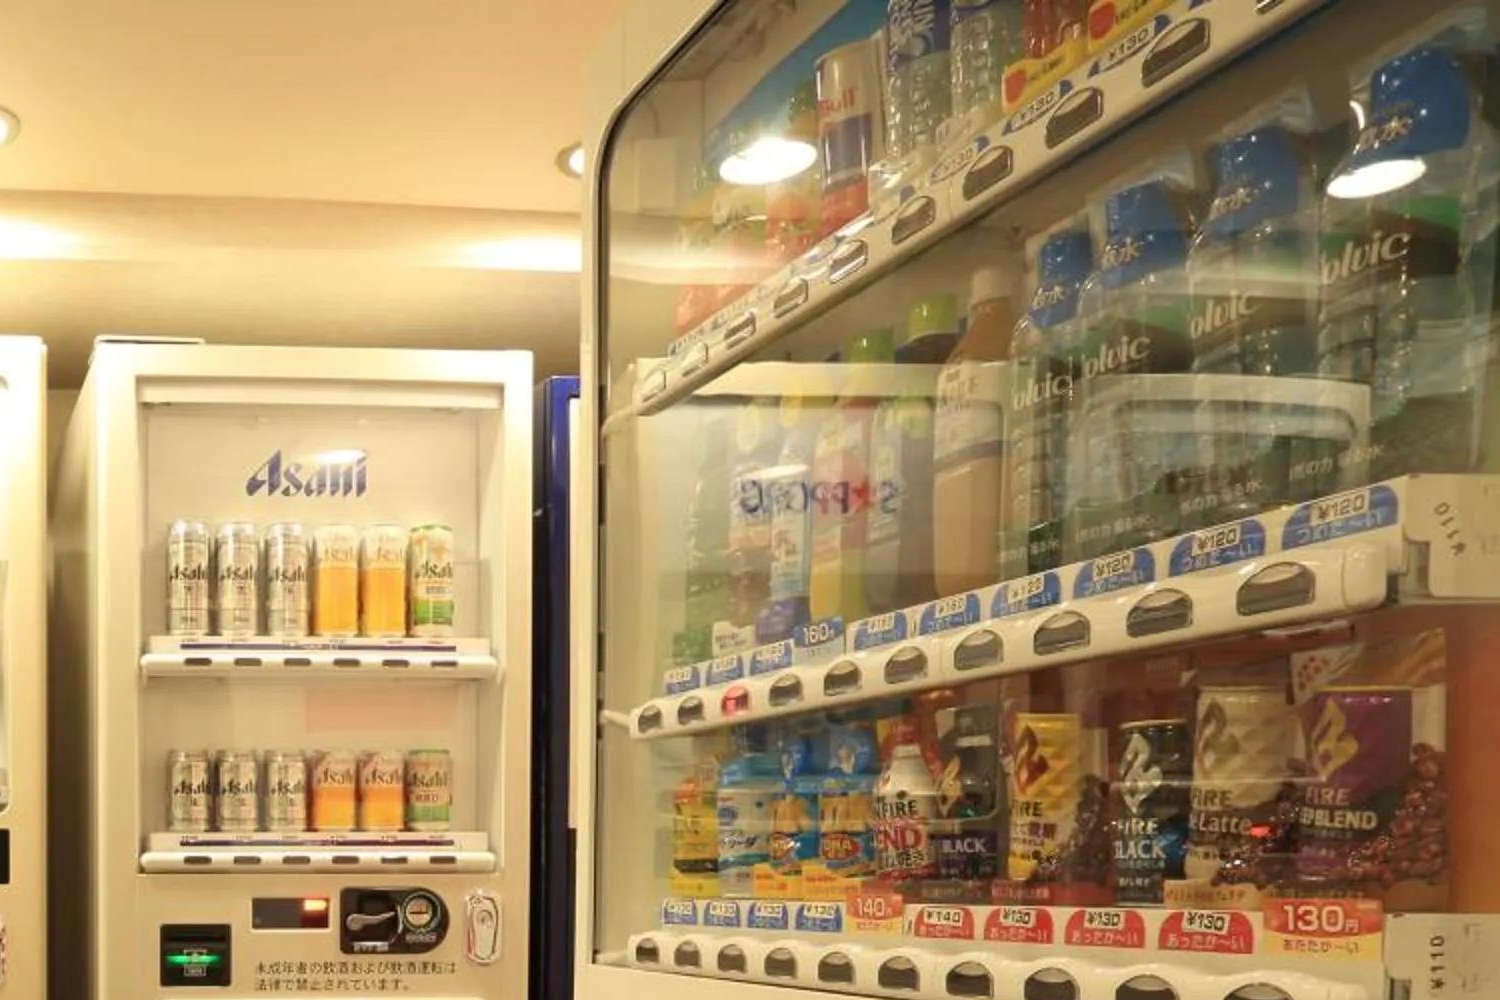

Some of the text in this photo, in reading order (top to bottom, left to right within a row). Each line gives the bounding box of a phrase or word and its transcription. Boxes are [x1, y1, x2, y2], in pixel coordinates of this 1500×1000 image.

[245, 449, 367, 497] Asahi
[1315, 494, 1366, 521] ¥120
[1197, 528, 1238, 552] ¥120
[1086, 911, 1121, 928] ¥130
[1186, 910, 1227, 933] ¥130
[1282, 904, 1360, 934] 130円
